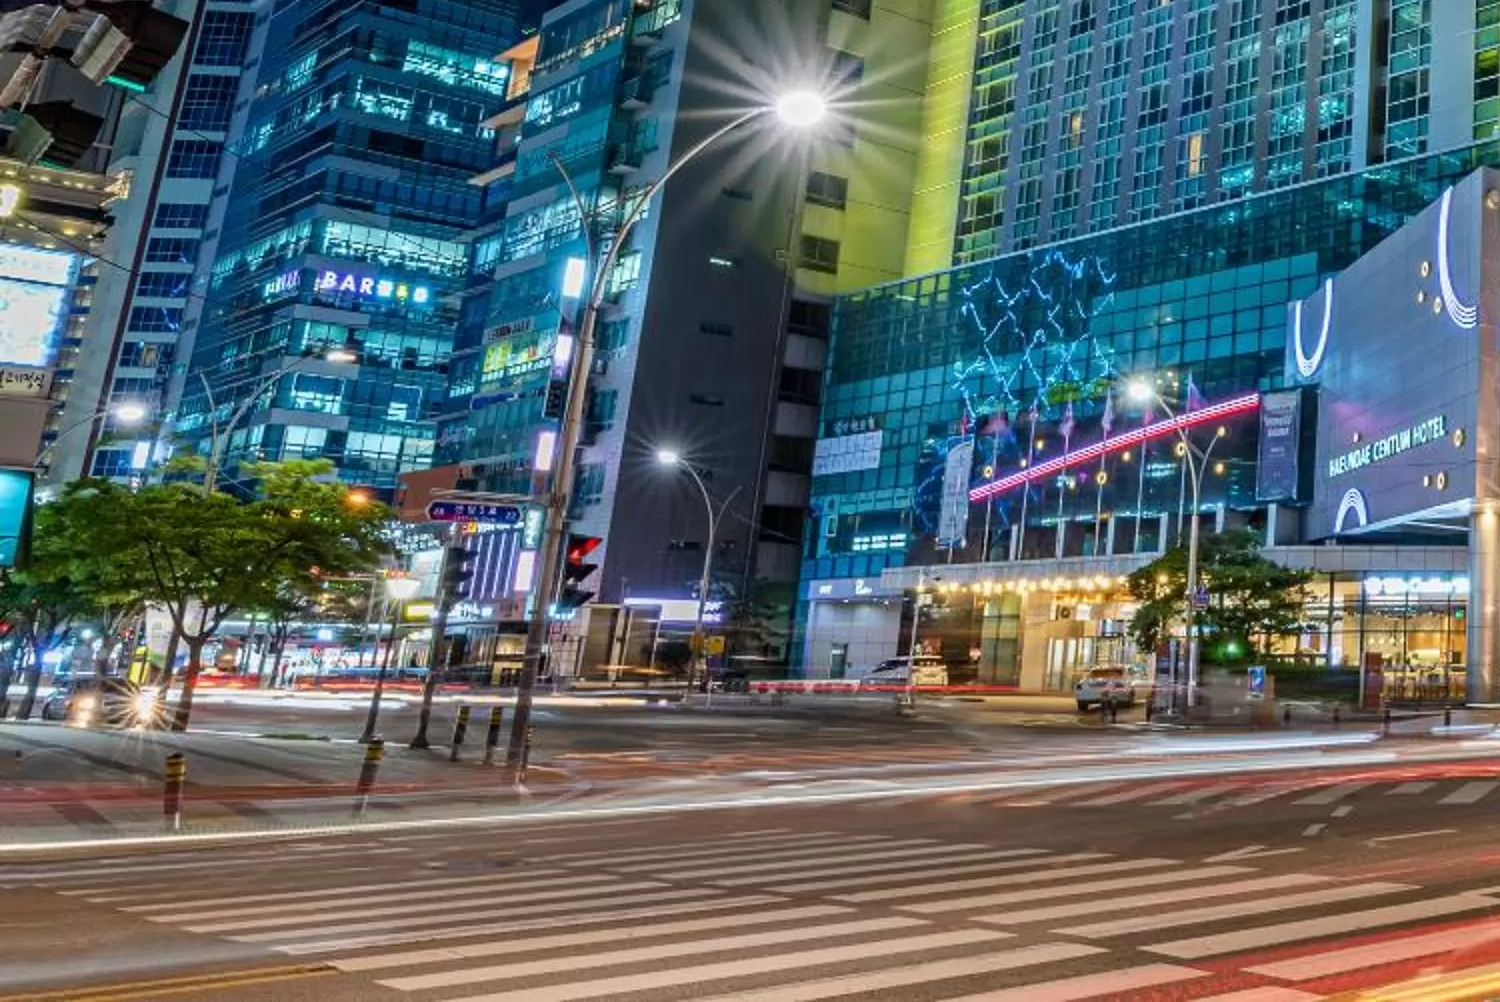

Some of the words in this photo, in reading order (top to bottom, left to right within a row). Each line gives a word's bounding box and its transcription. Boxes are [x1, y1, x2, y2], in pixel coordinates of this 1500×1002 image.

[1329, 444, 1371, 477] HAEUNDAE
[1374, 428, 1411, 461] CENTUM
[1413, 415, 1446, 444] HOTEL
